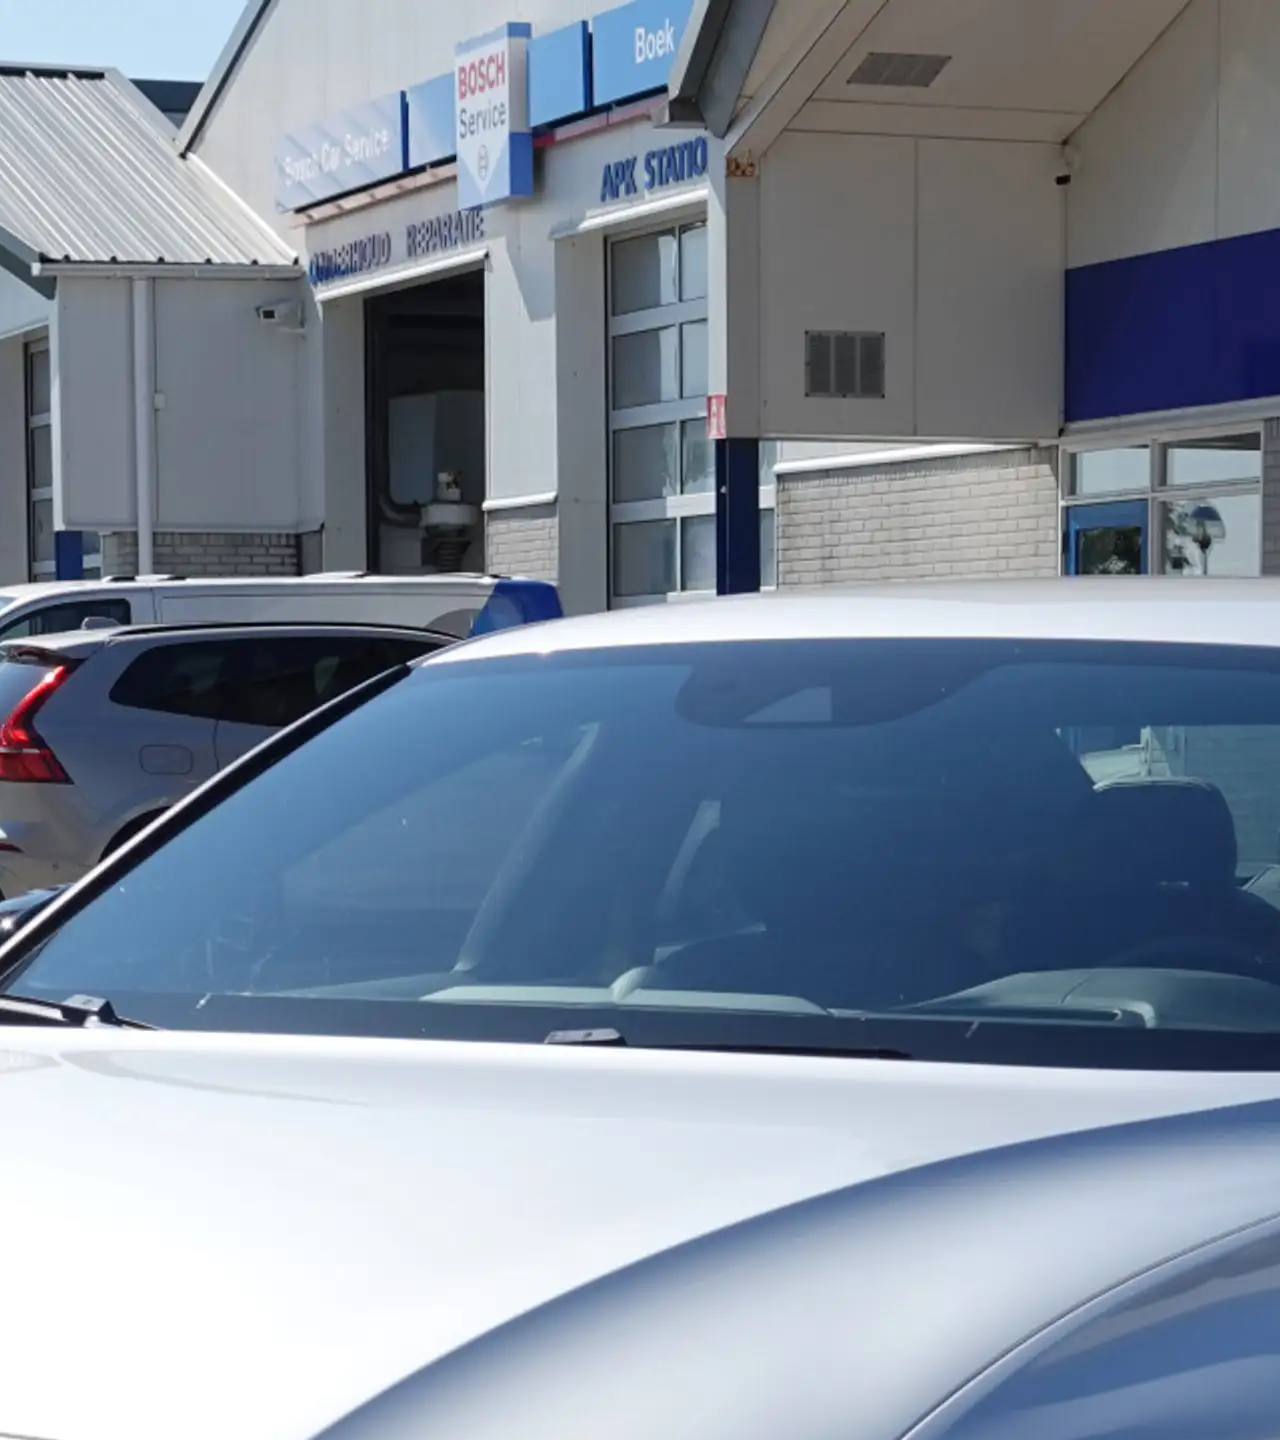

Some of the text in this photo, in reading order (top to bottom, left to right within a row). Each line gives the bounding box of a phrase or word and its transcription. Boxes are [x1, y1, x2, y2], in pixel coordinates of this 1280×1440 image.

[634, 18, 675, 64] Boek
[457, 51, 506, 100] BOSCH
[458, 102, 507, 139] Service
[345, 127, 390, 166] Service
[600, 156, 639, 203] APK
